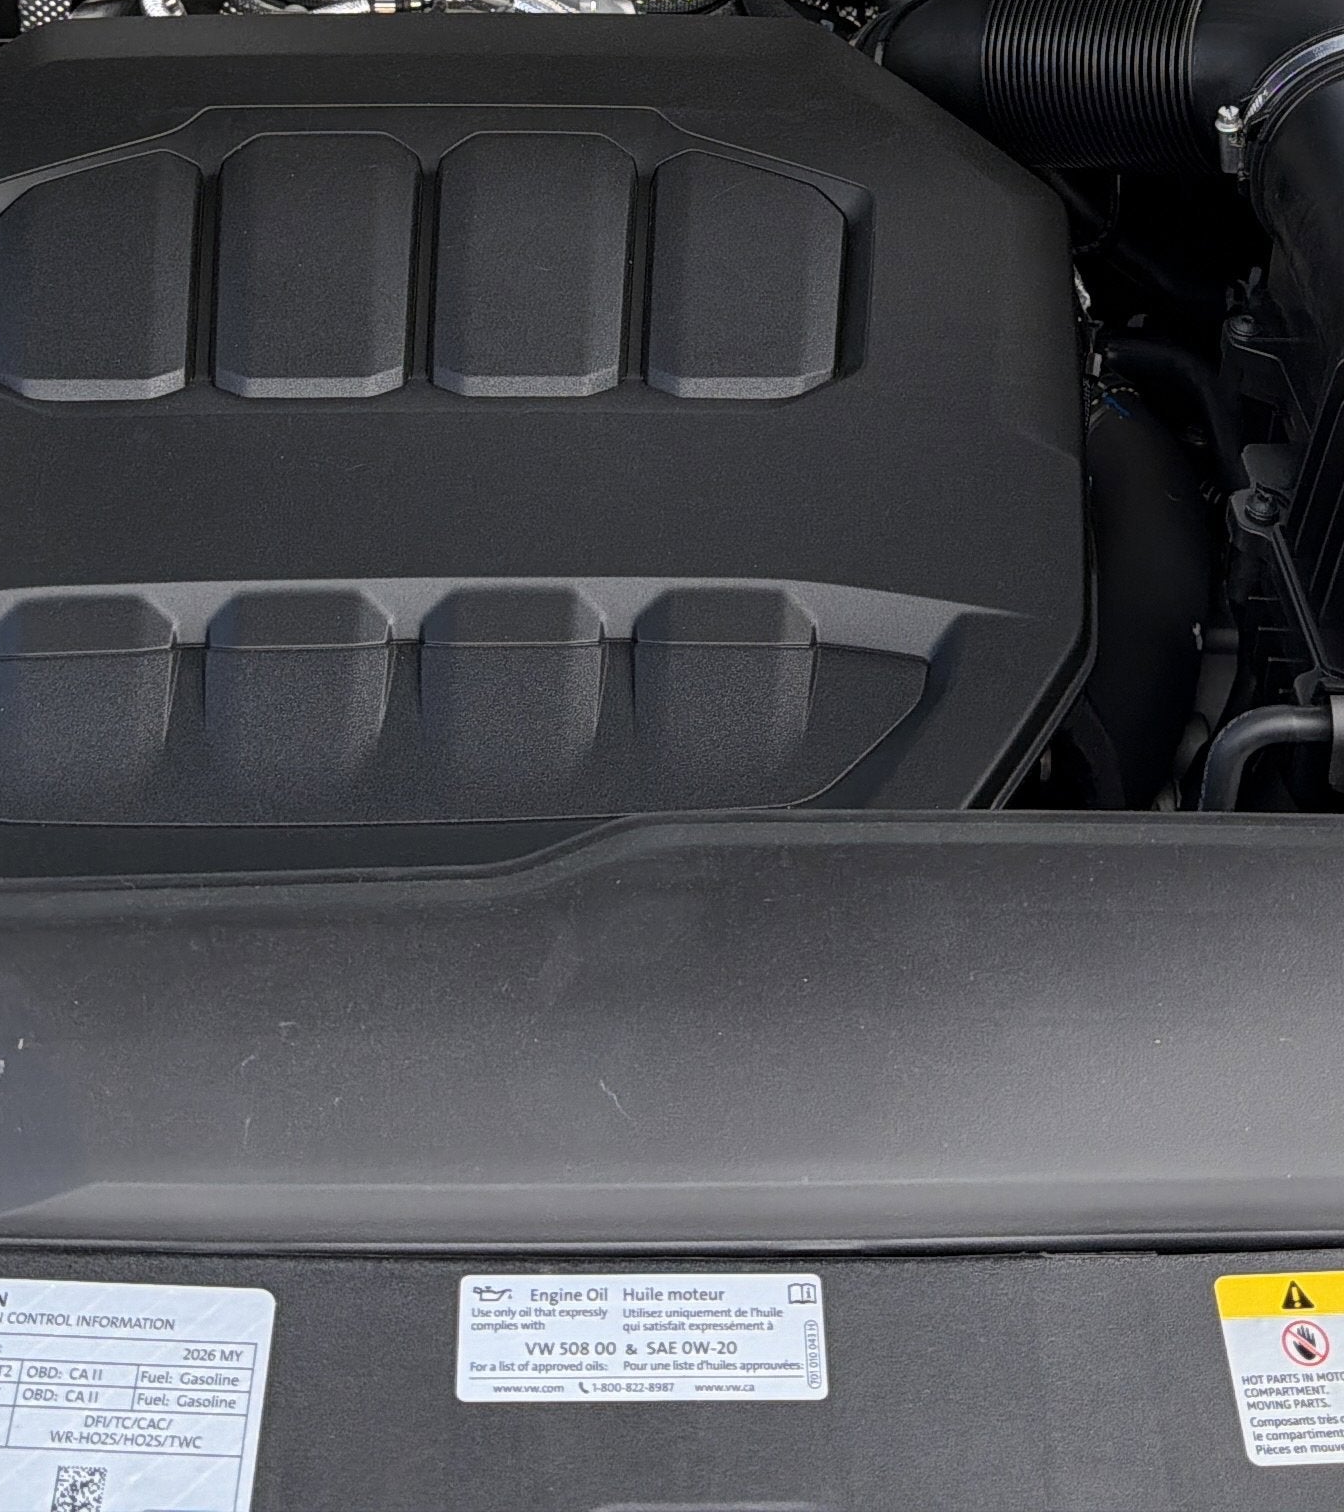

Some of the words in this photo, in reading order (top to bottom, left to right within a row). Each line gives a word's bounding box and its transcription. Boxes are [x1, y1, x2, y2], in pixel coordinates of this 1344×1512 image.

[530, 1288, 583, 1306] Engine
[586, 1287, 609, 1302] Oil
[622, 1287, 664, 1302] Huile
[667, 1288, 726, 1302] moteur
[471, 1308, 493, 1318] Use
[493, 1307, 517, 1319] only
[518, 1307, 532, 1318] oil
[534, 1307, 557, 1317] that
[558, 1307, 609, 1320] expressly
[622, 1308, 663, 1318] Utilisez
[665, 1307, 732, 1320] uniquement
[734, 1307, 748, 1318] de
[750, 1307, 784, 1318] l'huile
[7, 1311, 73, 1327] CONTROL
[76, 1315, 176, 1331] INFORMATION
[470, 1321, 519, 1333] complies
[520, 1320, 546, 1331] with
[622, 1321, 641, 1334] qui
[642, 1320, 686, 1331] satisfait
[182, 1348, 217, 1362] 2026
[219, 1348, 244, 1362] MY
[524, 1342, 556, 1356] VW
[559, 1341, 590, 1356] 508
[594, 1341, 617, 1356] 00
[625, 1343, 638, 1356] &
[646, 1341, 678, 1355] SAE
[681, 1340, 738, 1355] 0W-20
[469, 1361, 488, 1372] For
[489, 1363, 497, 1372] a
[498, 1361, 516, 1372] list
[517, 1361, 530, 1372] of
[531, 1361, 583, 1374] approved
[585, 1361, 609, 1372] oils:
[623, 1360, 648, 1371] Pour
[650, 1362, 671, 1371] une
[672, 1360, 696, 1371] liste
[26, 1366, 62, 1380] OBD:
[69, 1367, 90, 1381] CA
[140, 1371, 173, 1385] Fuel:
[179, 1372, 240, 1387] Gasoline
[1241, 1374, 1264, 1385] HOT
[1266, 1373, 1300, 1384] PARTS
[1302, 1372, 1314, 1383] IN
[22, 1387, 58, 1402] OBD:
[64, 1389, 87, 1403] CA
[493, 1384, 565, 1394] www.vw.com
[592, 1382, 675, 1393] 1-800-822-8987
[694, 1383, 755, 1392] www.vw.ca
[1243, 1385, 1330, 1398] COMPARTMENT.
[136, 1392, 170, 1407] Fuel:
[176, 1394, 237, 1409] Gasoline
[1246, 1399, 1292, 1411] MOVING
[1293, 1398, 1332, 1409] PARTS.
[1249, 1415, 1316, 1428] Composants
[1317, 1413, 1339, 1424] très
[1253, 1431, 1264, 1441] le
[1266, 1428, 1344, 1442] compartiment
[1255, 1443, 1292, 1455] Pièces
[1293, 1445, 1308, 1454] en
